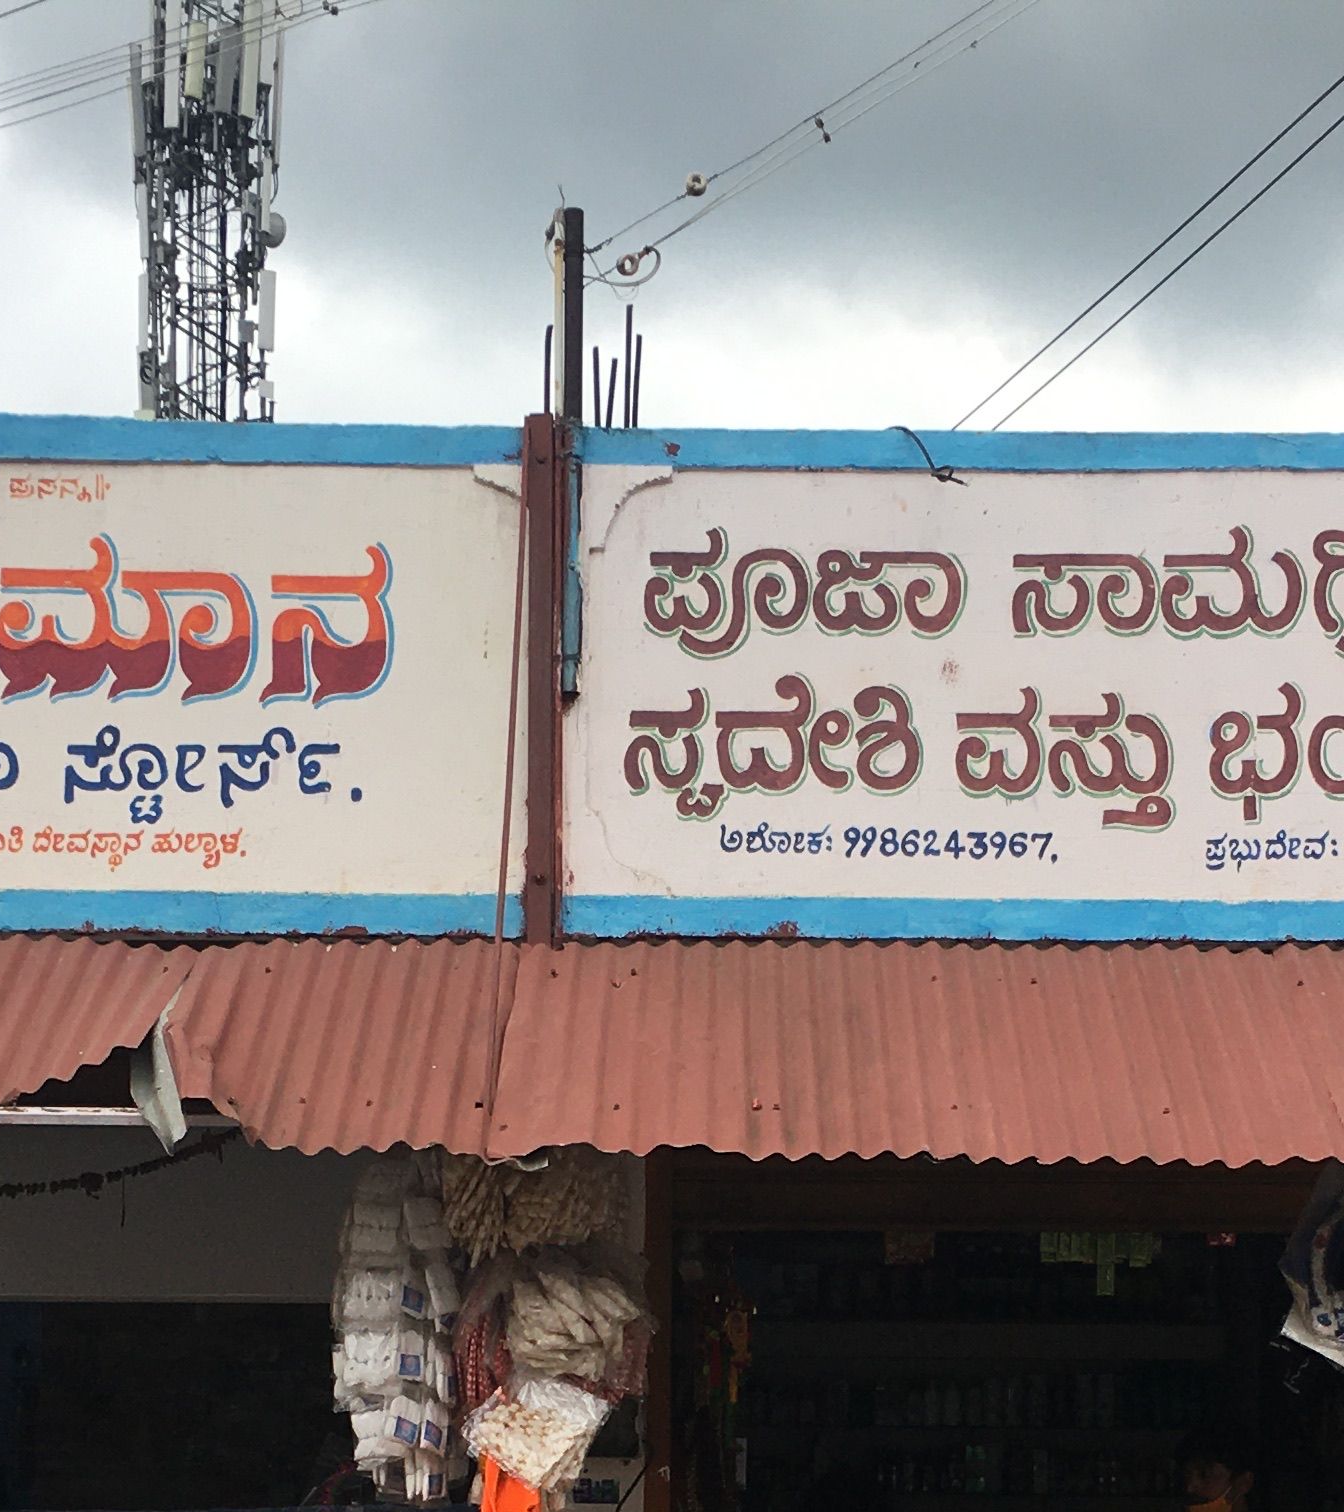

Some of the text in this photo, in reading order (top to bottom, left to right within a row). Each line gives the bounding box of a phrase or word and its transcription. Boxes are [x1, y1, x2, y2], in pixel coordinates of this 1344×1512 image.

[643, 528, 968, 661] ಪೂಜಾ
[622, 672, 925, 820] ಸ್ವದೇಶಿ
[954, 686, 1175, 833] ವಸ್ತು
[32, 825, 144, 872] ದೇವಸ್ಥಾನ
